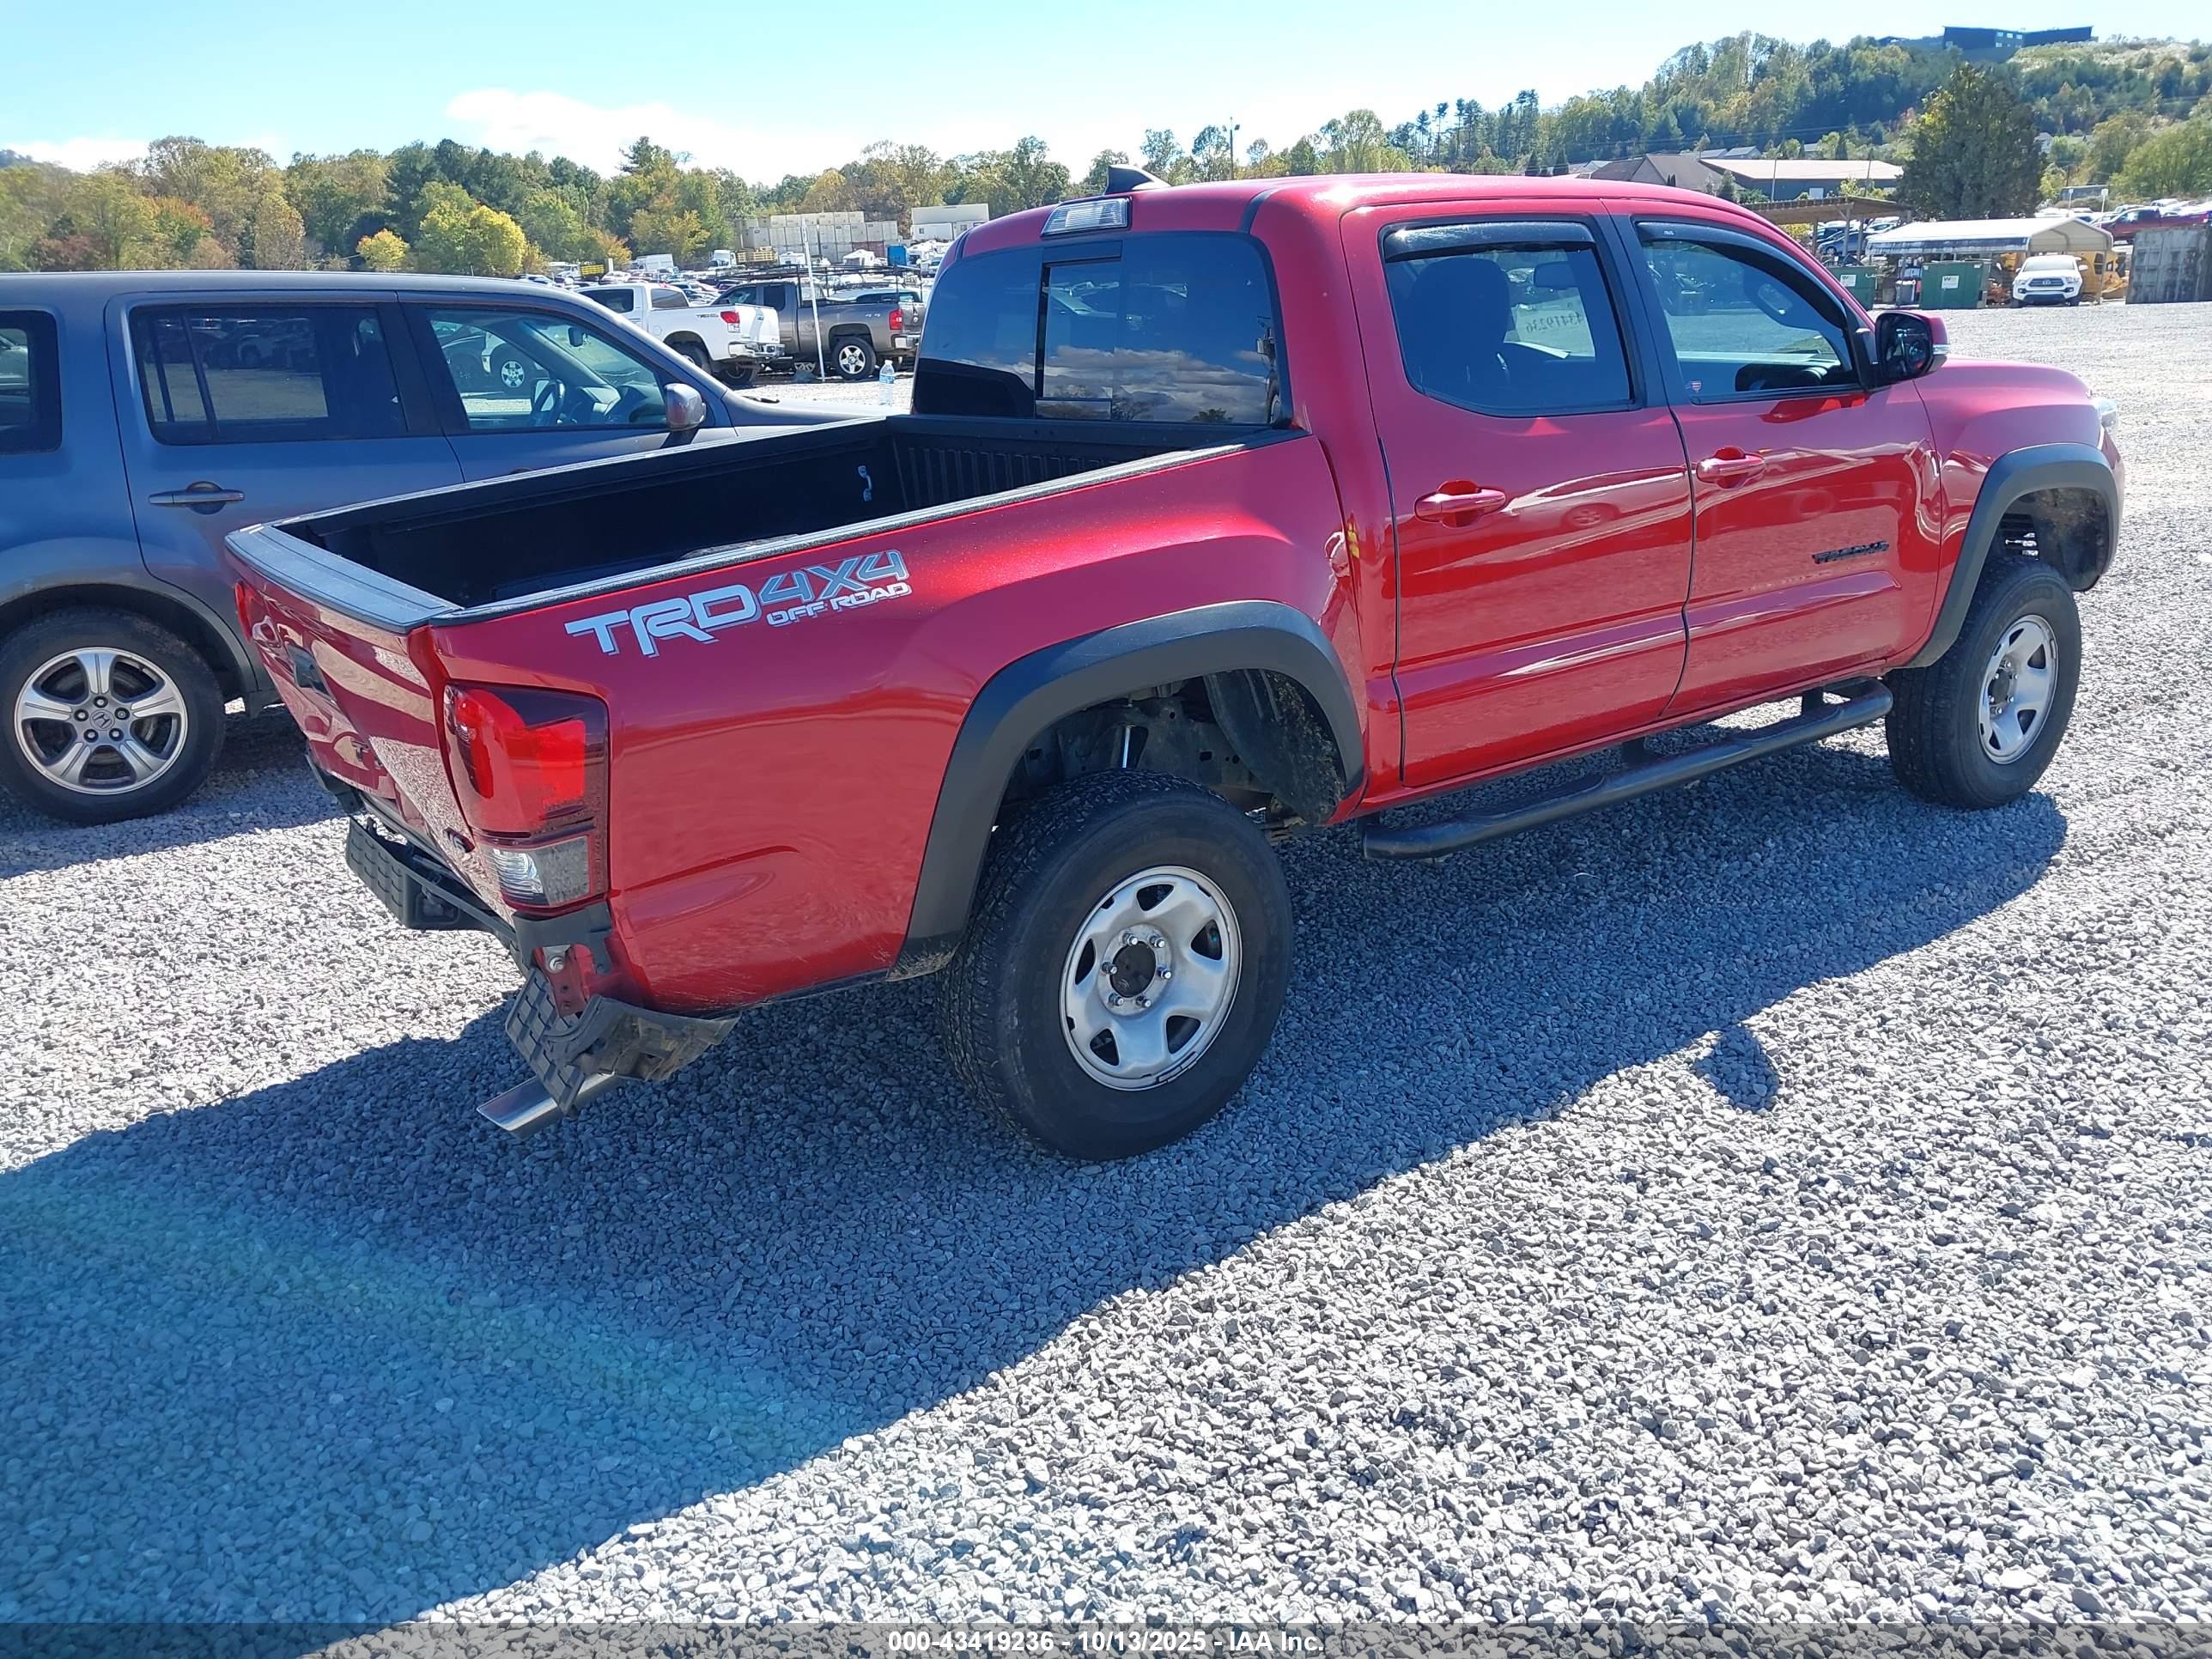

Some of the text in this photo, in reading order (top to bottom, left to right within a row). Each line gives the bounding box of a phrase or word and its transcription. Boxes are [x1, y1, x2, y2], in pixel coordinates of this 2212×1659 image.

[565, 585, 761, 657] TRD
[766, 581, 913, 627] OFF ROAD
